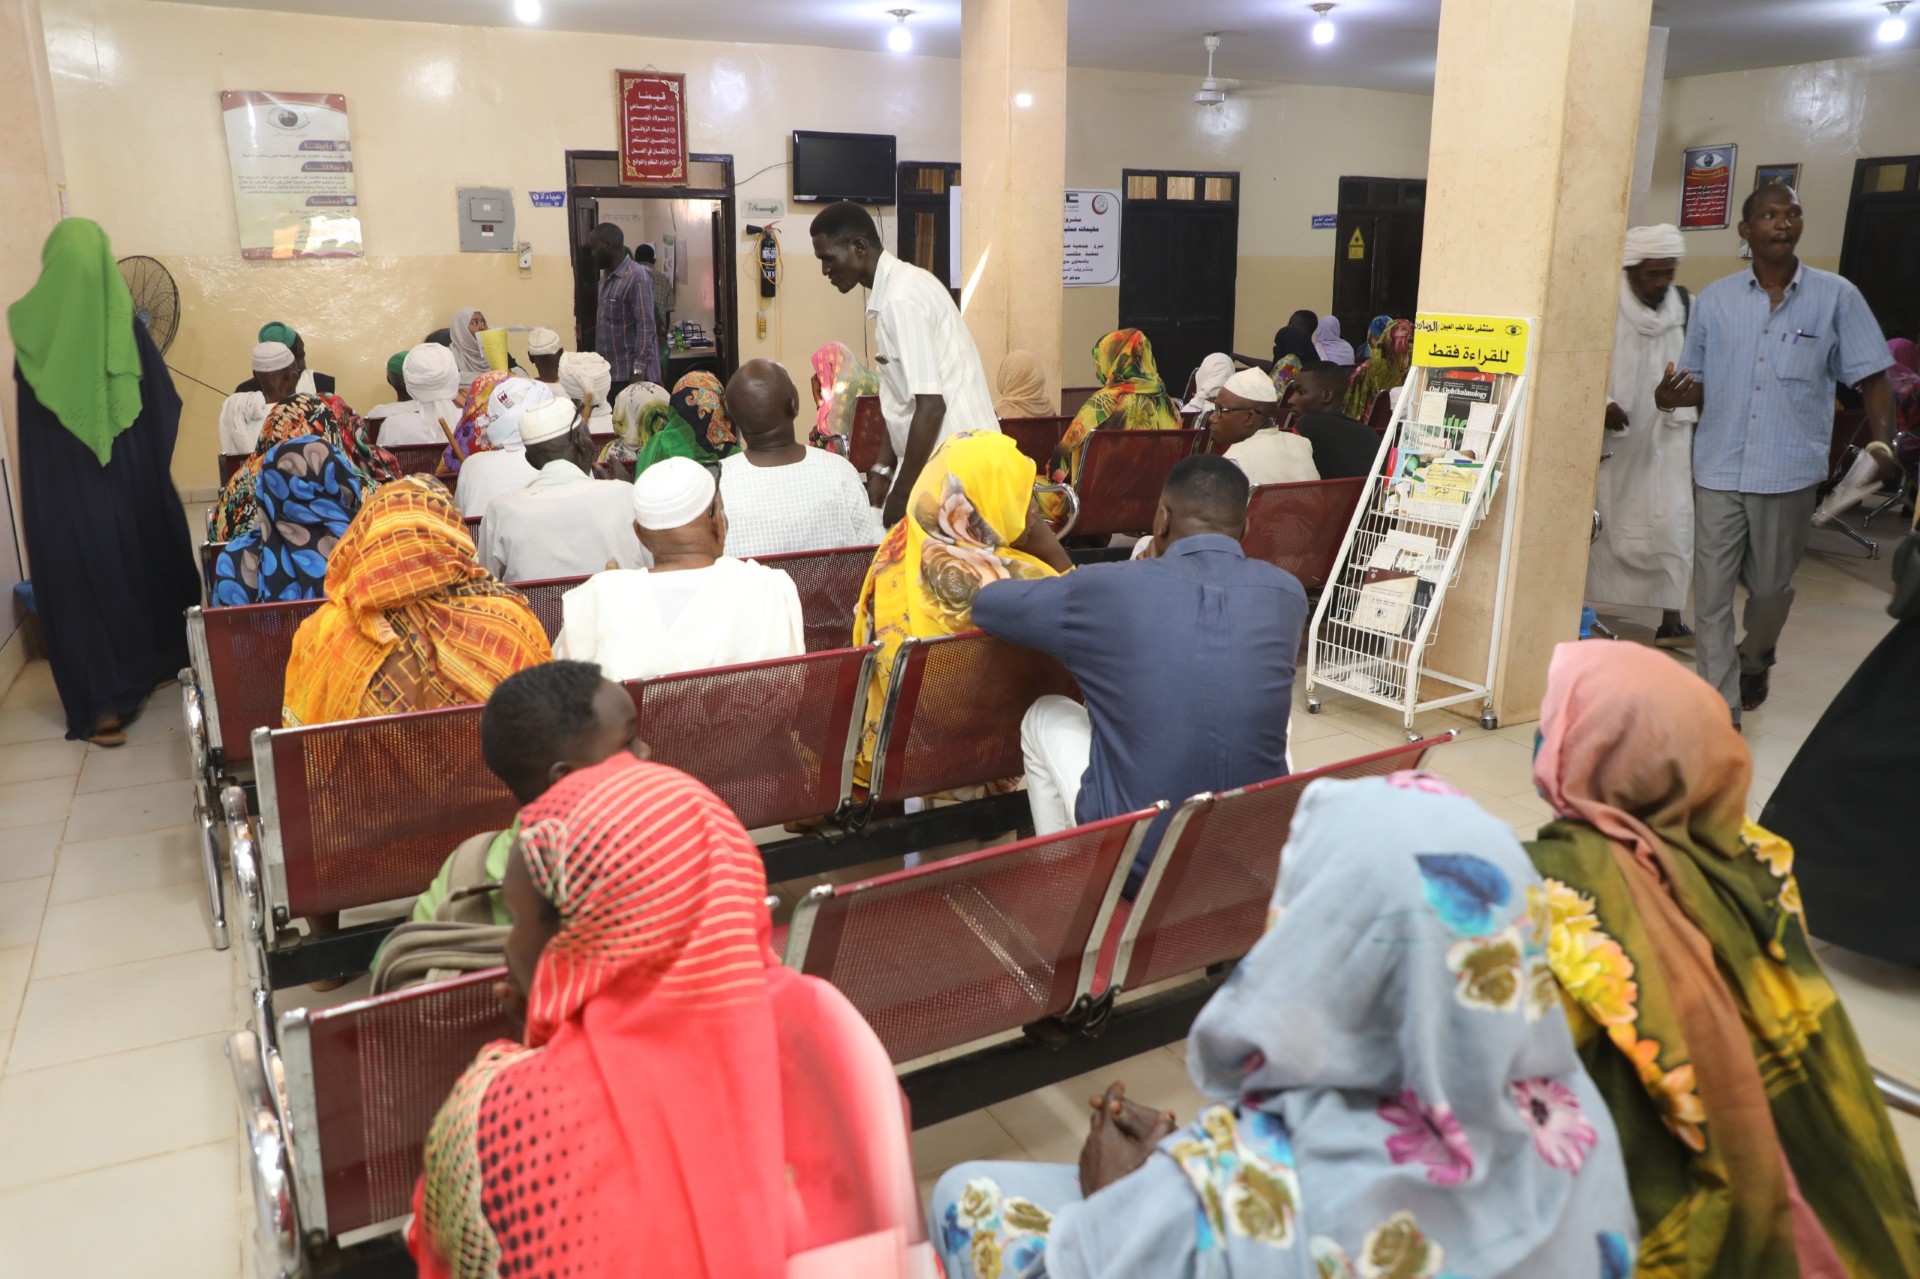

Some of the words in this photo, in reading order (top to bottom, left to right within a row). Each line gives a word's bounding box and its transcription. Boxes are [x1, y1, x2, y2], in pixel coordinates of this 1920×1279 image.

[638, 91, 666, 101] قيمنا
[540, 192, 561, 201] عيادة
[1440, 323, 1454, 331] العيون
[1455, 323, 1466, 331] لطب
[1475, 324, 1494, 333] مستشفى
[1428, 343, 1460, 359] فقط
[1462, 346, 1510, 366] للقراءة
[1442, 386, 1487, 399] Ophthalmology
